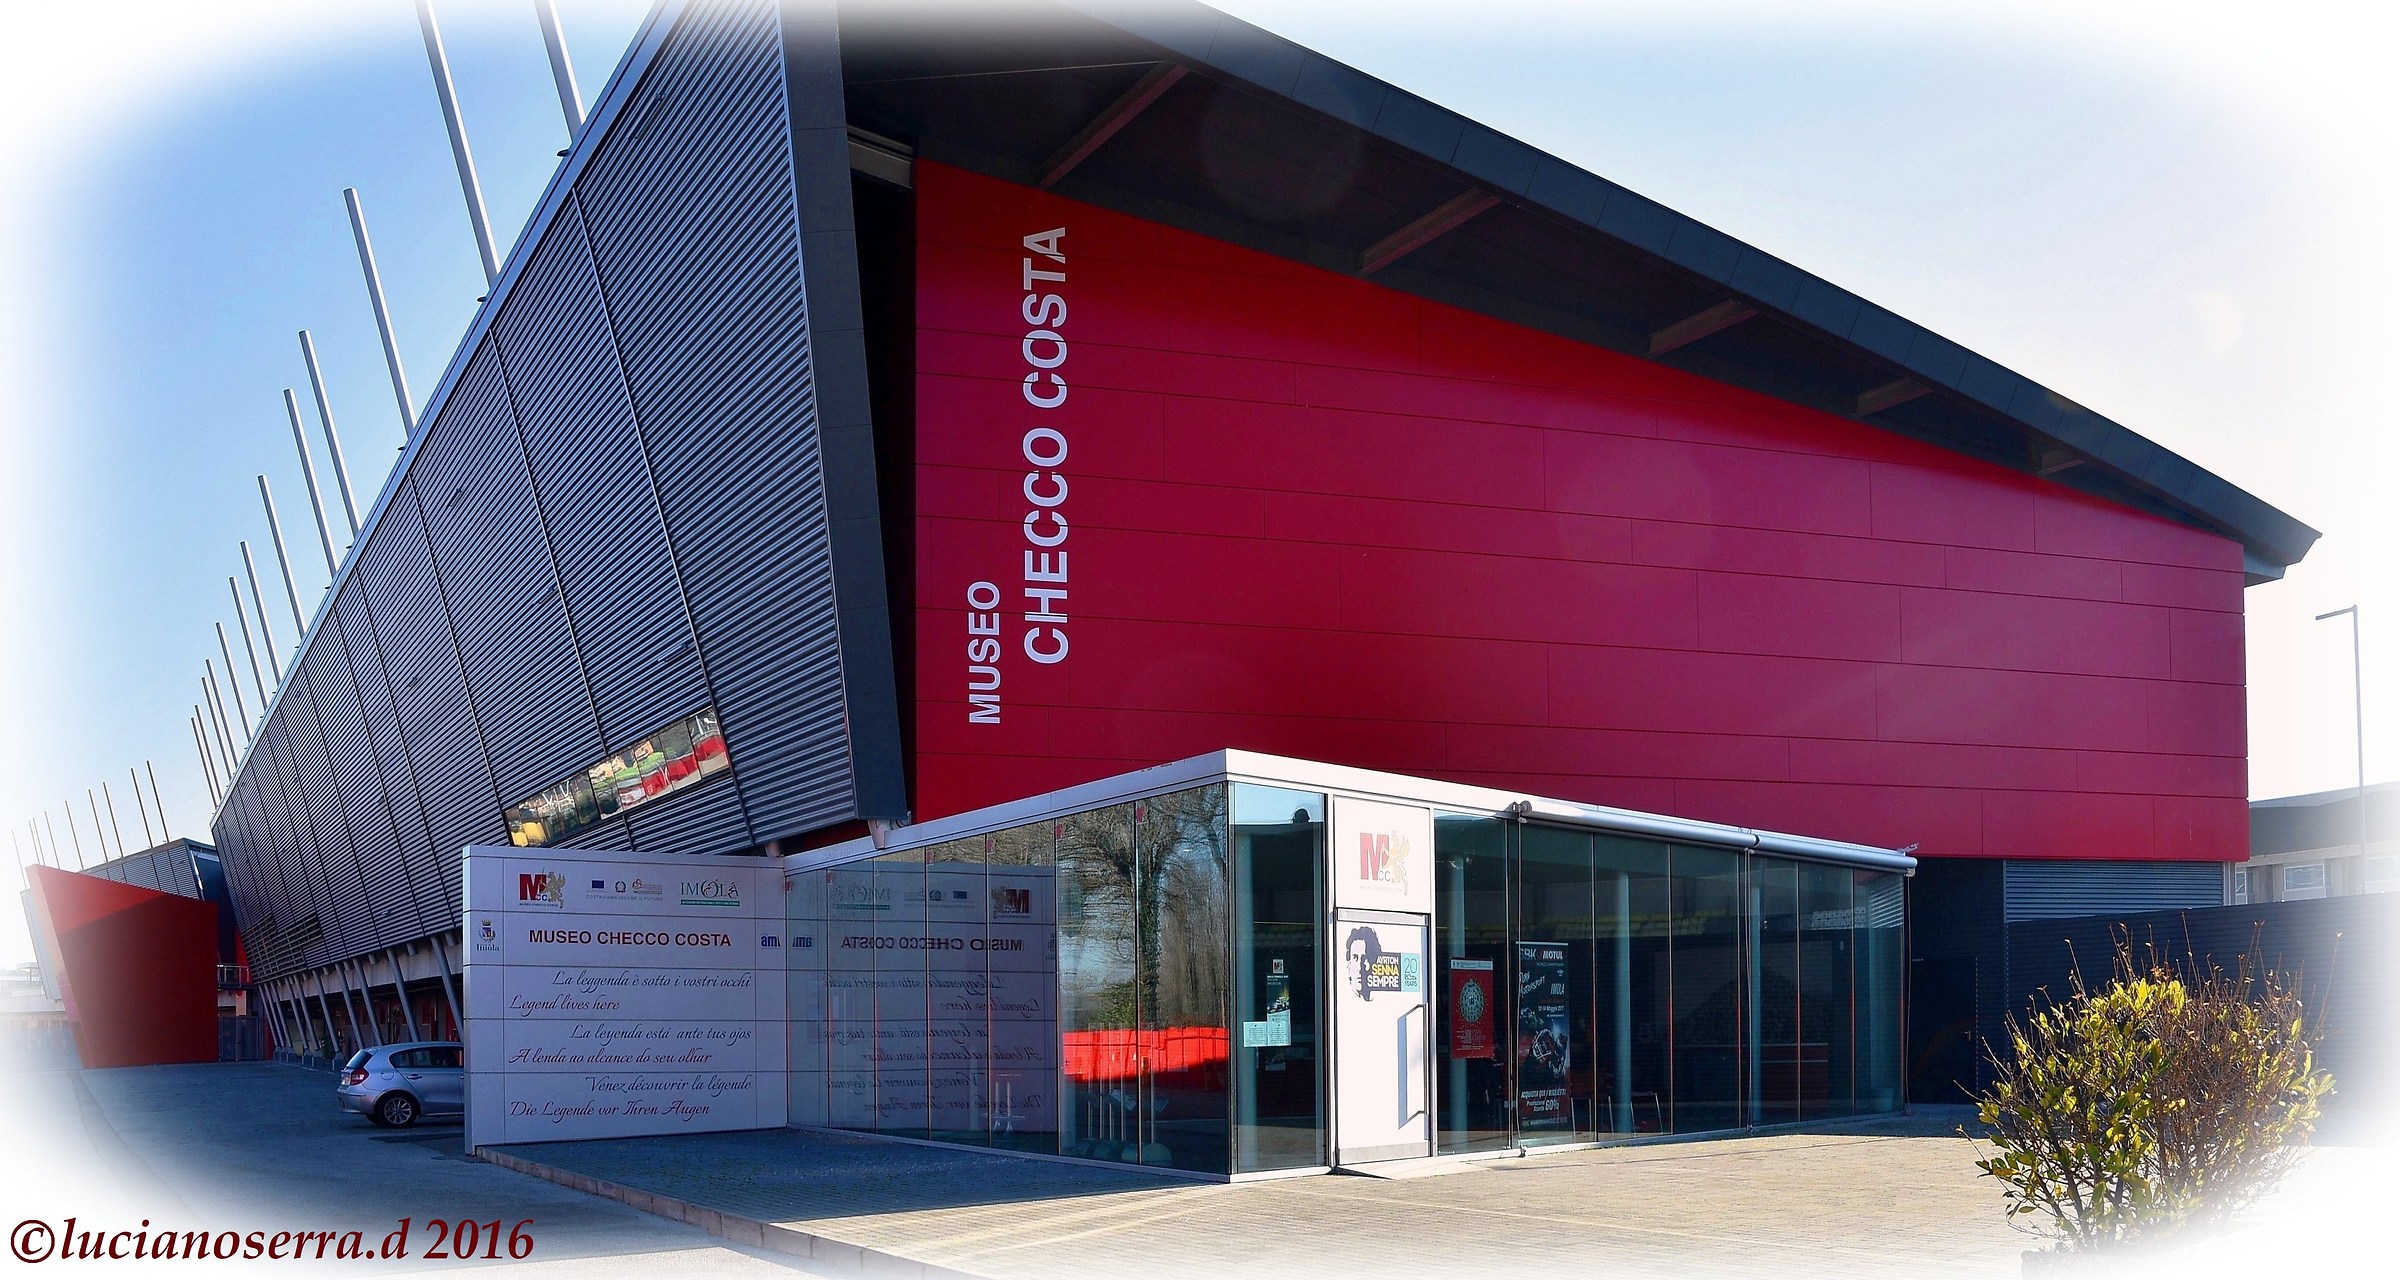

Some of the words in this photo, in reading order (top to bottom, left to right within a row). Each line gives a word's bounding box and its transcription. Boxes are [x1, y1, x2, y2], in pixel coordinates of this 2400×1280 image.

[1022, 227, 1068, 409] COSTA
[1022, 428, 1069, 665] CHECCO
[967, 581, 1001, 724] MUSEO
[680, 878, 740, 899] IMOLA
[529, 929, 592, 944] MUSEO
[597, 931, 670, 945] CHECCO
[675, 933, 732, 947] COSTA
[1371, 963, 1400, 976] SENNA
[1376, 956, 1399, 965] AYRTON
[1404, 957, 1418, 974] 20
[552, 971, 573, 986] La
[576, 969, 629, 993] leggenda
[632, 974, 640, 986] è
[642, 975, 670, 987] sotto
[674, 975, 681, 987] i
[683, 975, 719, 988] vostri
[720, 971, 752, 988] occhi
[1367, 975, 1400, 988] SEMPRE
[508, 994, 564, 1017] Legend
[560, 993, 590, 1010] lives
[592, 994, 621, 1010] here
[570, 1023, 592, 1039] La
[594, 1022, 643, 1047] leyenda
[645, 1027, 671, 1039] está
[676, 1027, 703, 1039] ante
[706, 1027, 726, 1039] tus
[725, 1026, 752, 1047] ojos
[508, 1047, 532, 1063] A
[532, 1047, 567, 1063] lenda
[569, 1054, 585, 1063] ao
[587, 1048, 633, 1063] alcance
[635, 1047, 650, 1063] do
[653, 1055, 675, 1063] seu
[678, 1047, 713, 1063] olhar
[585, 1075, 628, 1093] Venez
[627, 1074, 689, 1091] découvrir
[691, 1075, 705, 1090] la
[707, 1074, 752, 1097] légende
[510, 1101, 537, 1116] Die
[541, 1100, 595, 1123] Legende
[598, 1107, 620, 1116] vor
[621, 1099, 659, 1116] Ihren
[661, 1099, 711, 1122] Augen
